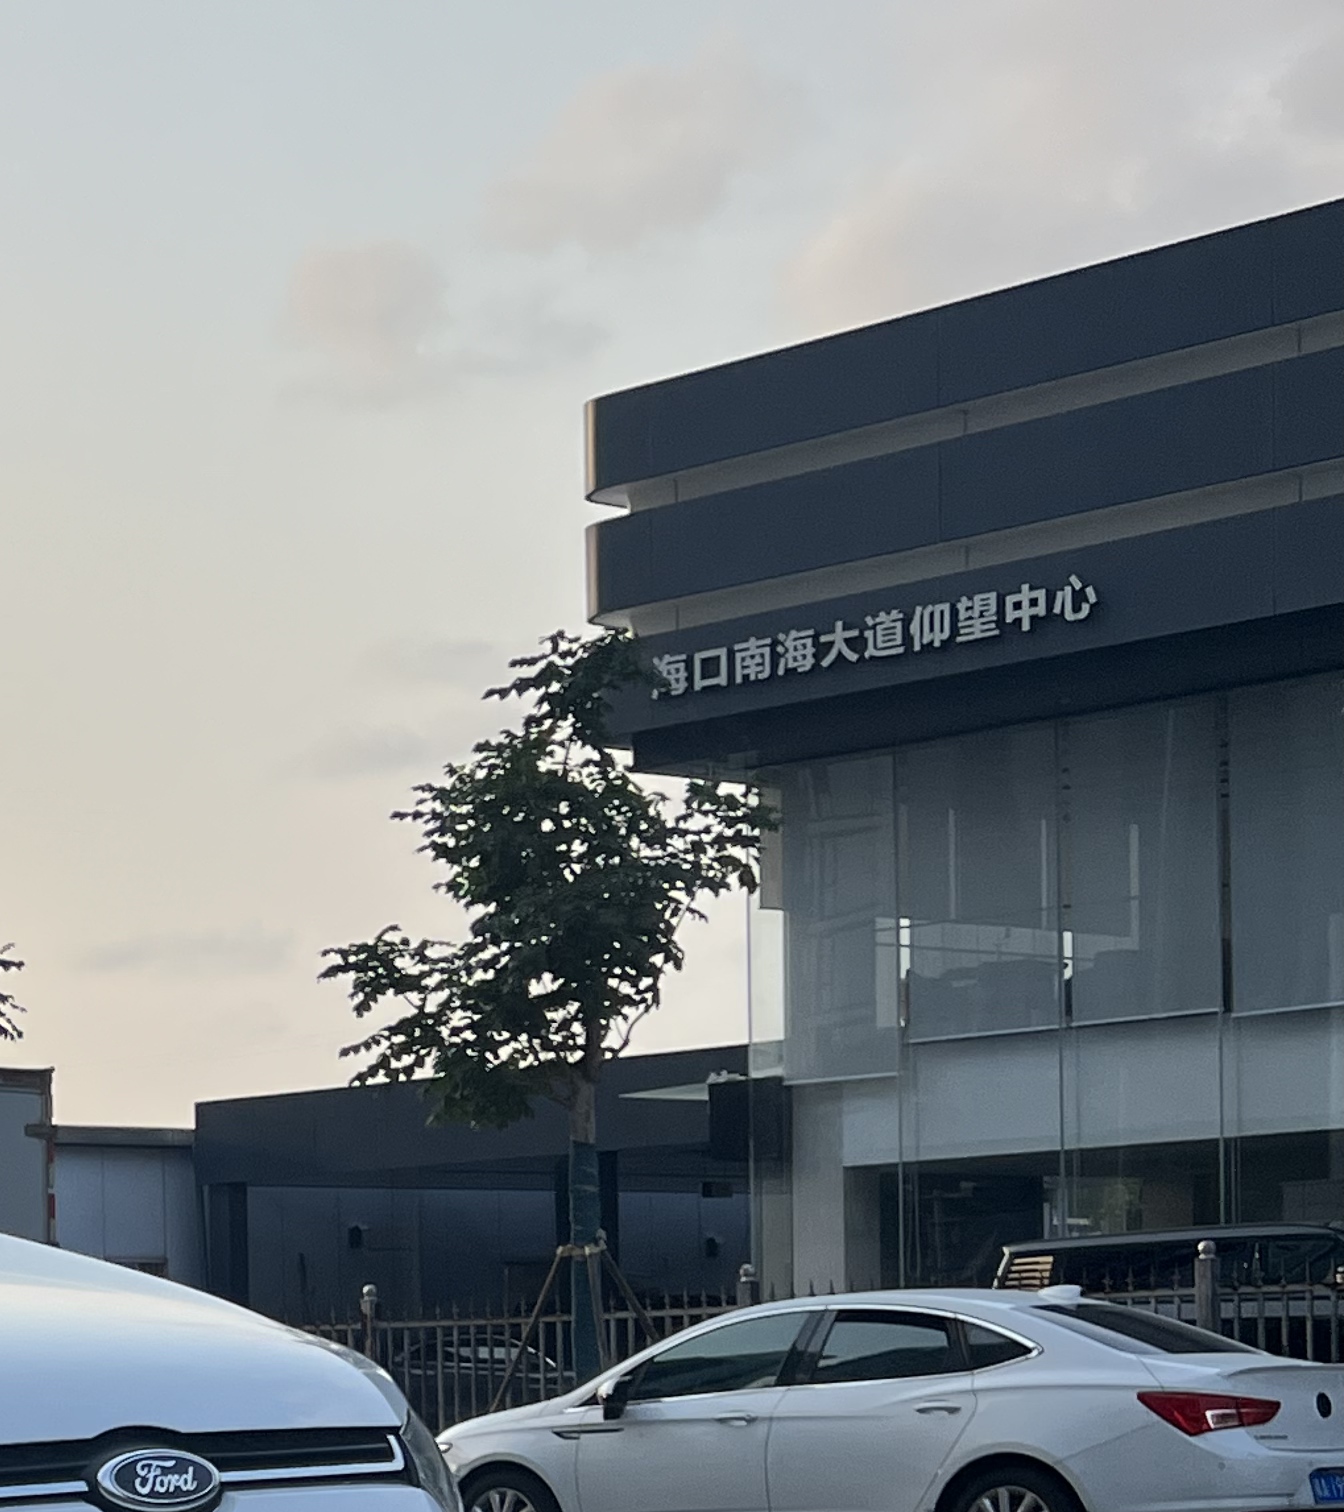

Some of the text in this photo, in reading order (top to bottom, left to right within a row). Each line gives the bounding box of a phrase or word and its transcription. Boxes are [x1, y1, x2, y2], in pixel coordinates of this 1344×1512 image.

[651, 574, 1098, 700] 海口南海大道仰望中心
[134, 1459, 198, 1496] Ford
